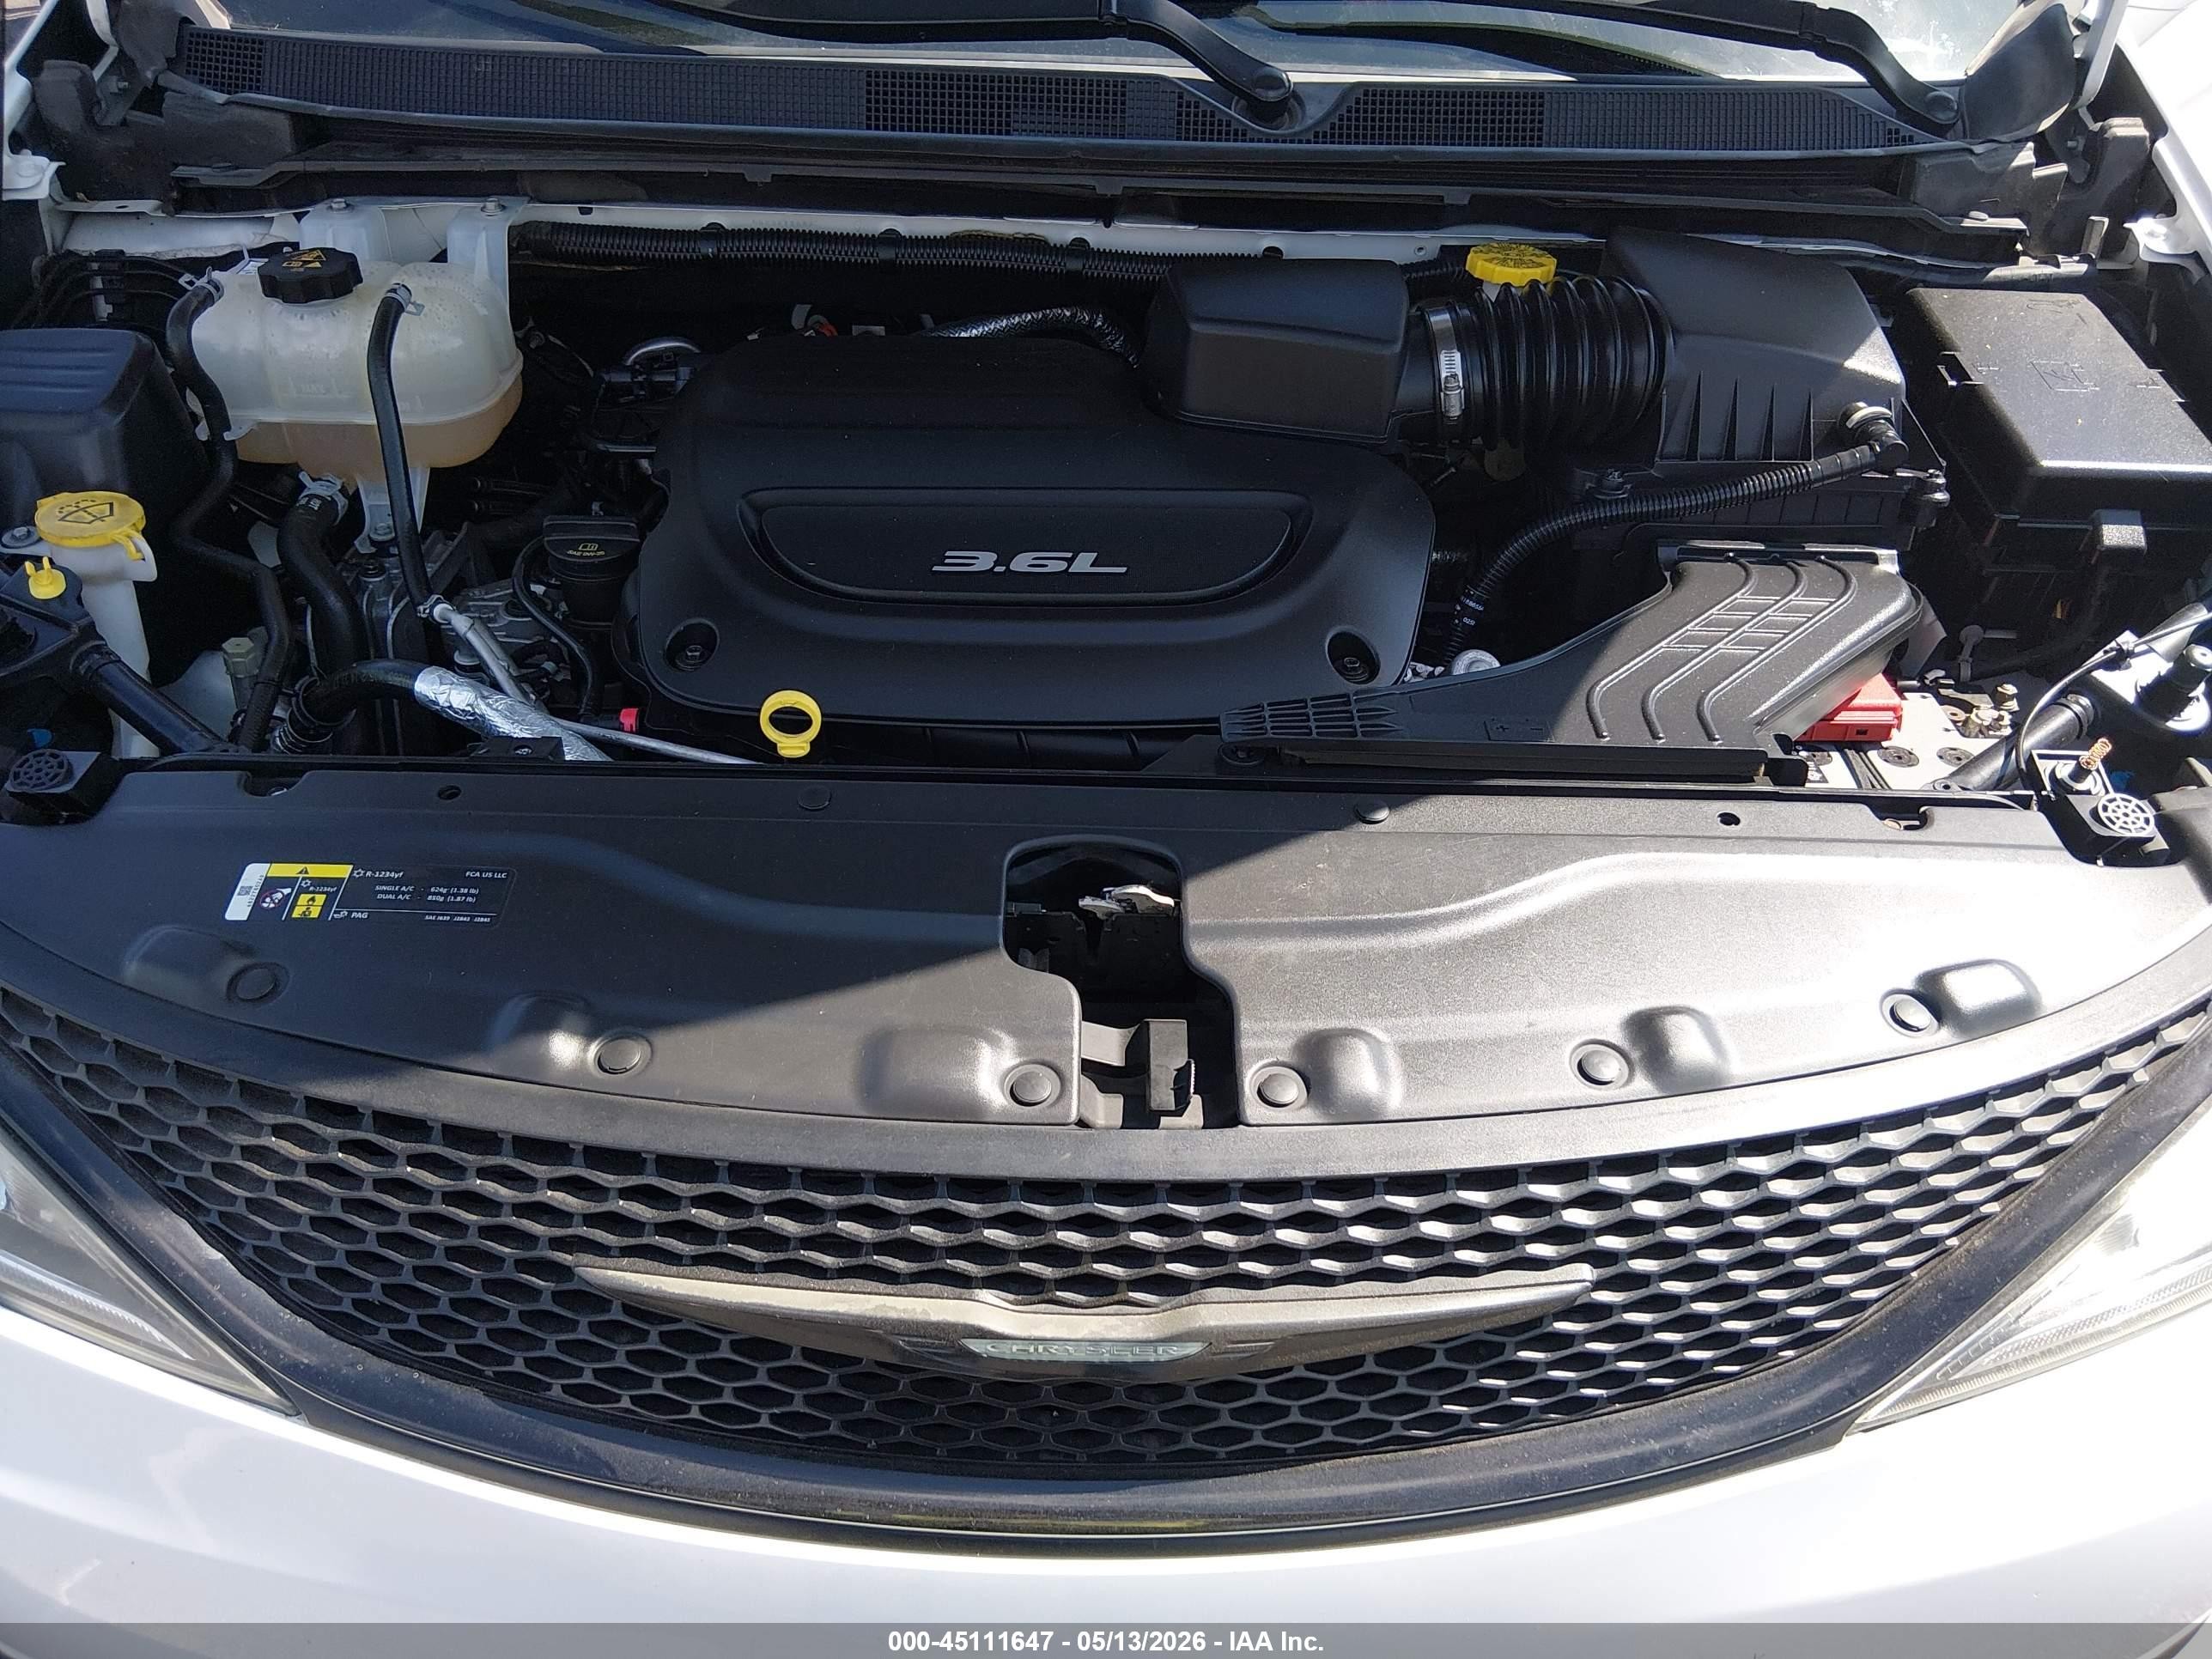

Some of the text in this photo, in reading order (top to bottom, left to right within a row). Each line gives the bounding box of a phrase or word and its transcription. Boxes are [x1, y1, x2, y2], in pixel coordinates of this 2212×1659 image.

[931, 550, 1128, 573] 3.6L
[365, 870, 404, 878] R-1234yf
[987, 1343, 1180, 1357] CHRYSLER
